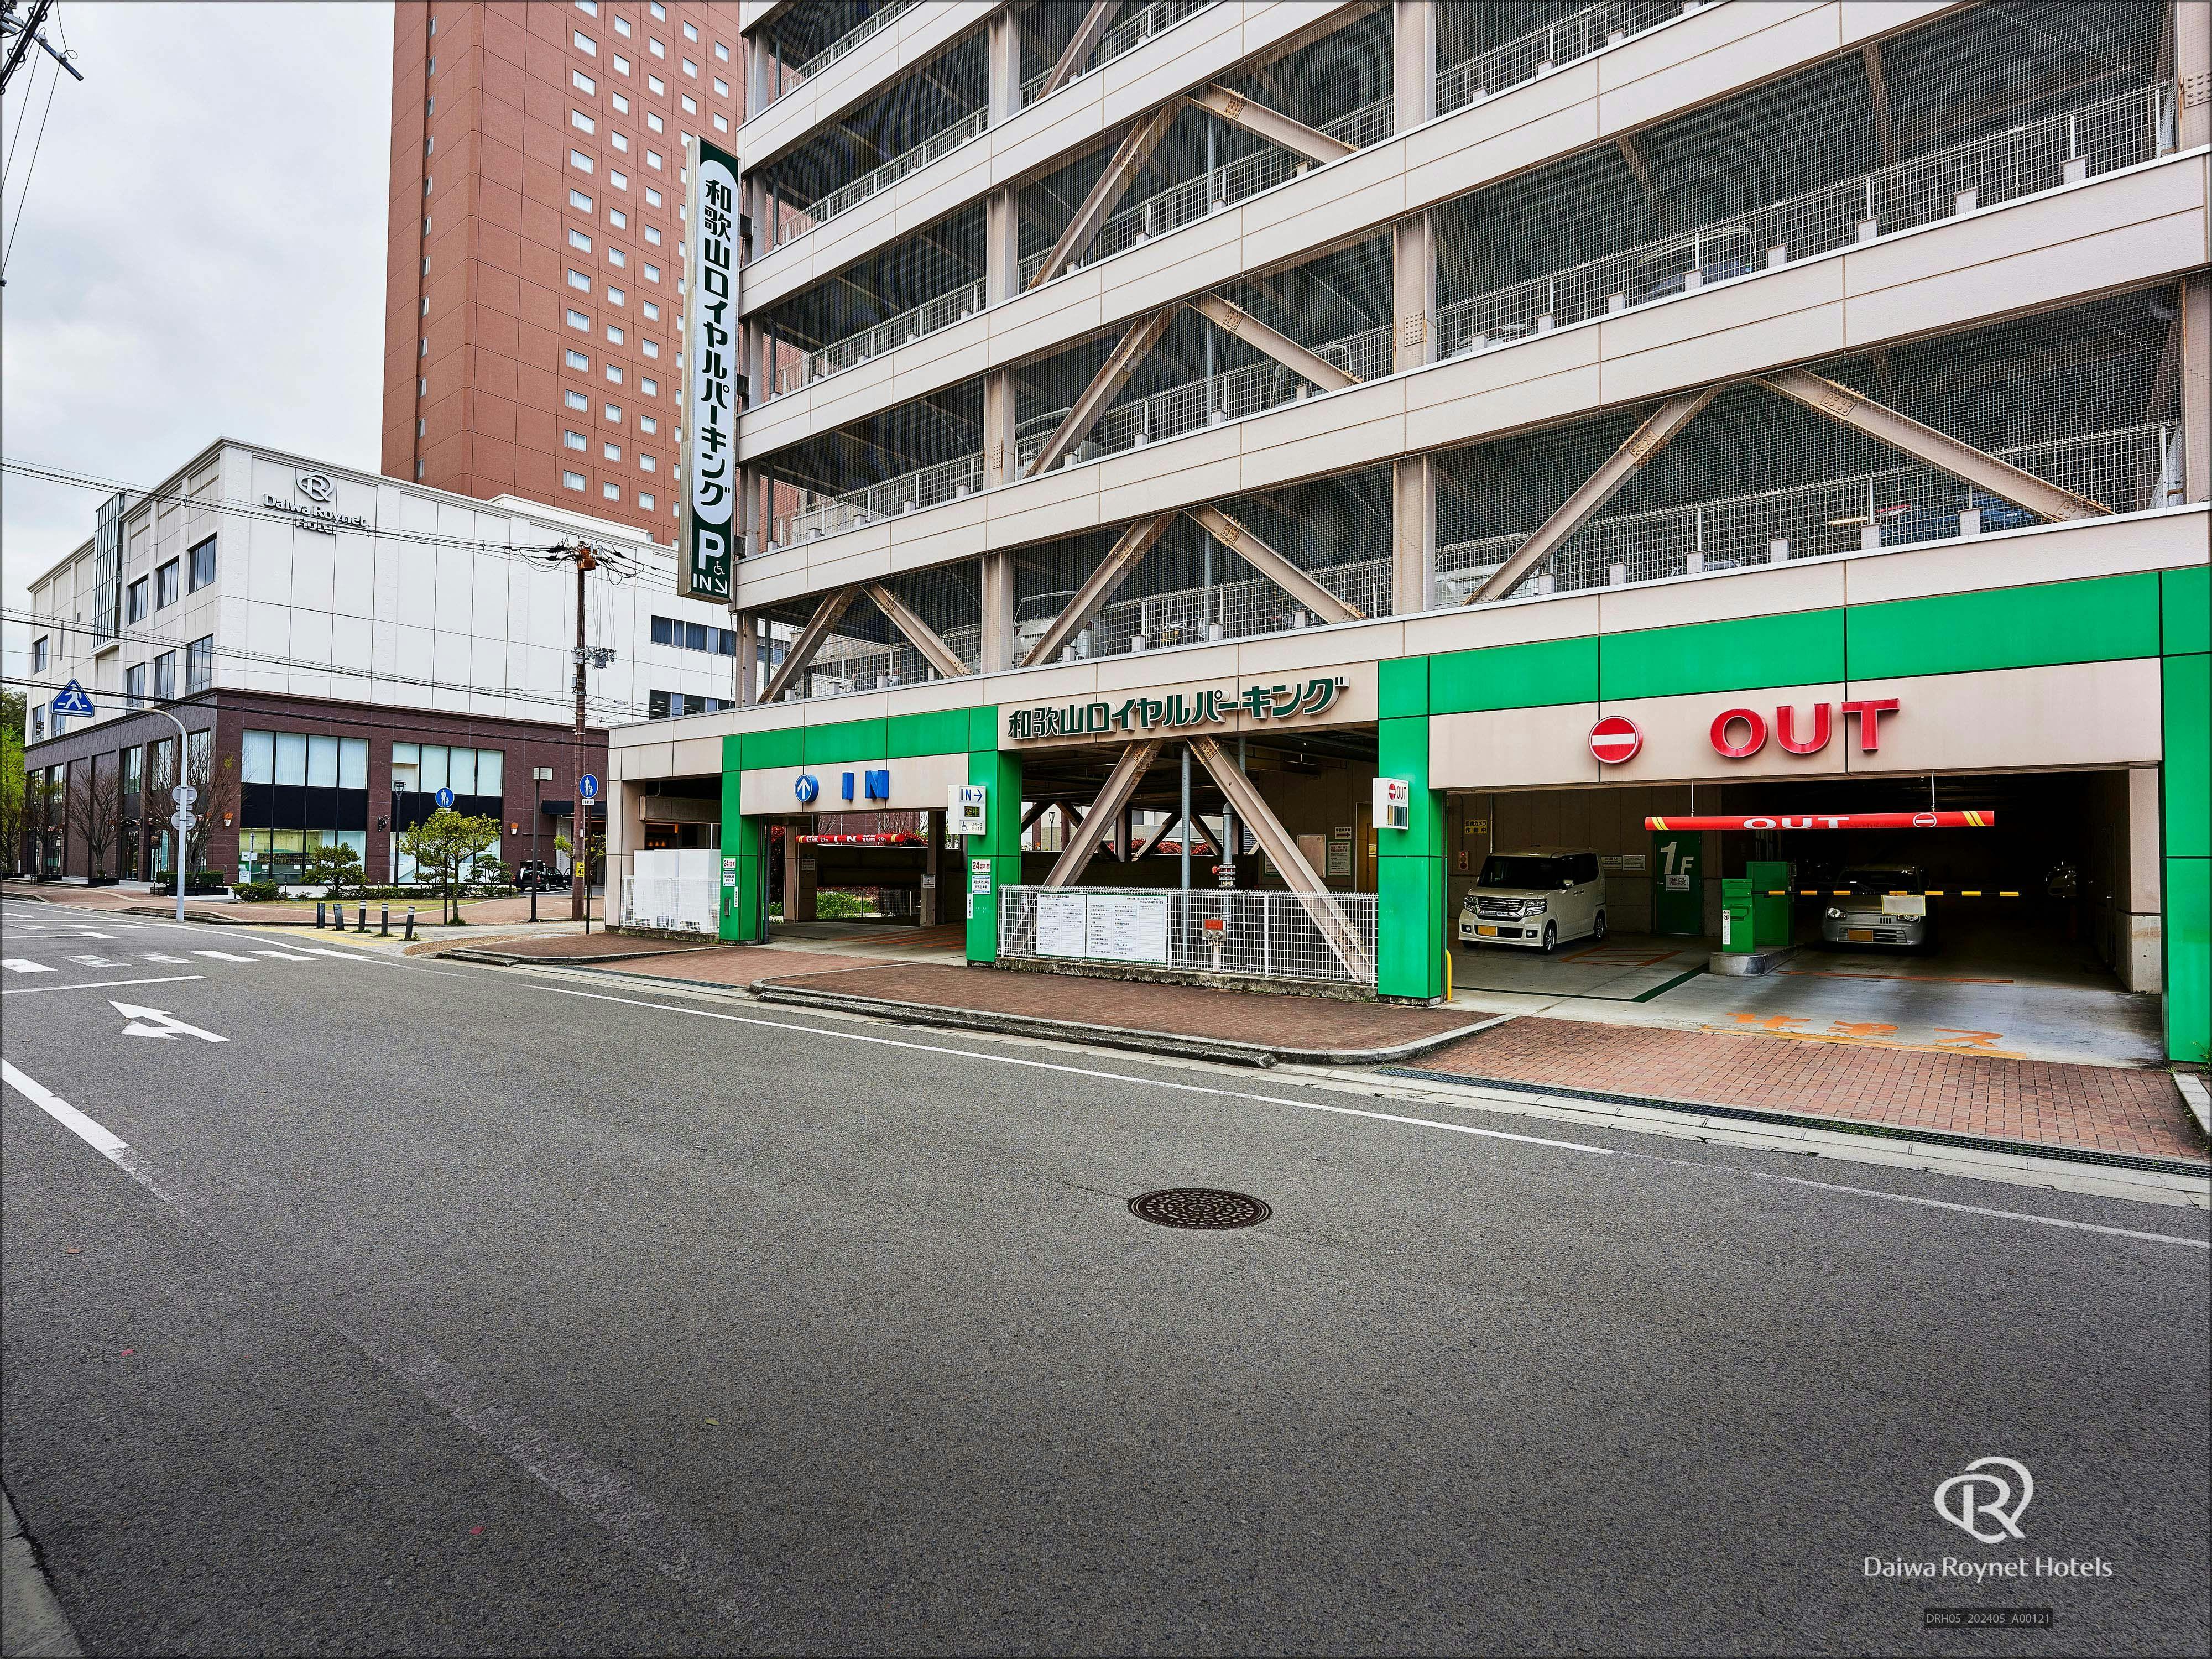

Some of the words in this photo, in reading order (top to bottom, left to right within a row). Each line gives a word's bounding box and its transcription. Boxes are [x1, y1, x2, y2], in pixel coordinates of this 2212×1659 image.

[700, 179, 732, 506] 和歌山ロイヤルパーキング
[263, 494, 311, 514] Daiwa
[314, 505, 367, 526] Roynet
[698, 529, 725, 570] P
[693, 573, 711, 591] IN
[1008, 676, 1350, 740] 和歌山ロイヤルパーキング
[1710, 698, 1900, 758] OUT
[842, 770, 889, 800] IN
[961, 789, 972, 801] IN
[1396, 786, 1406, 800] OUT
[1743, 817, 1850, 829] OUT
[1661, 842, 1694, 875] 1F
